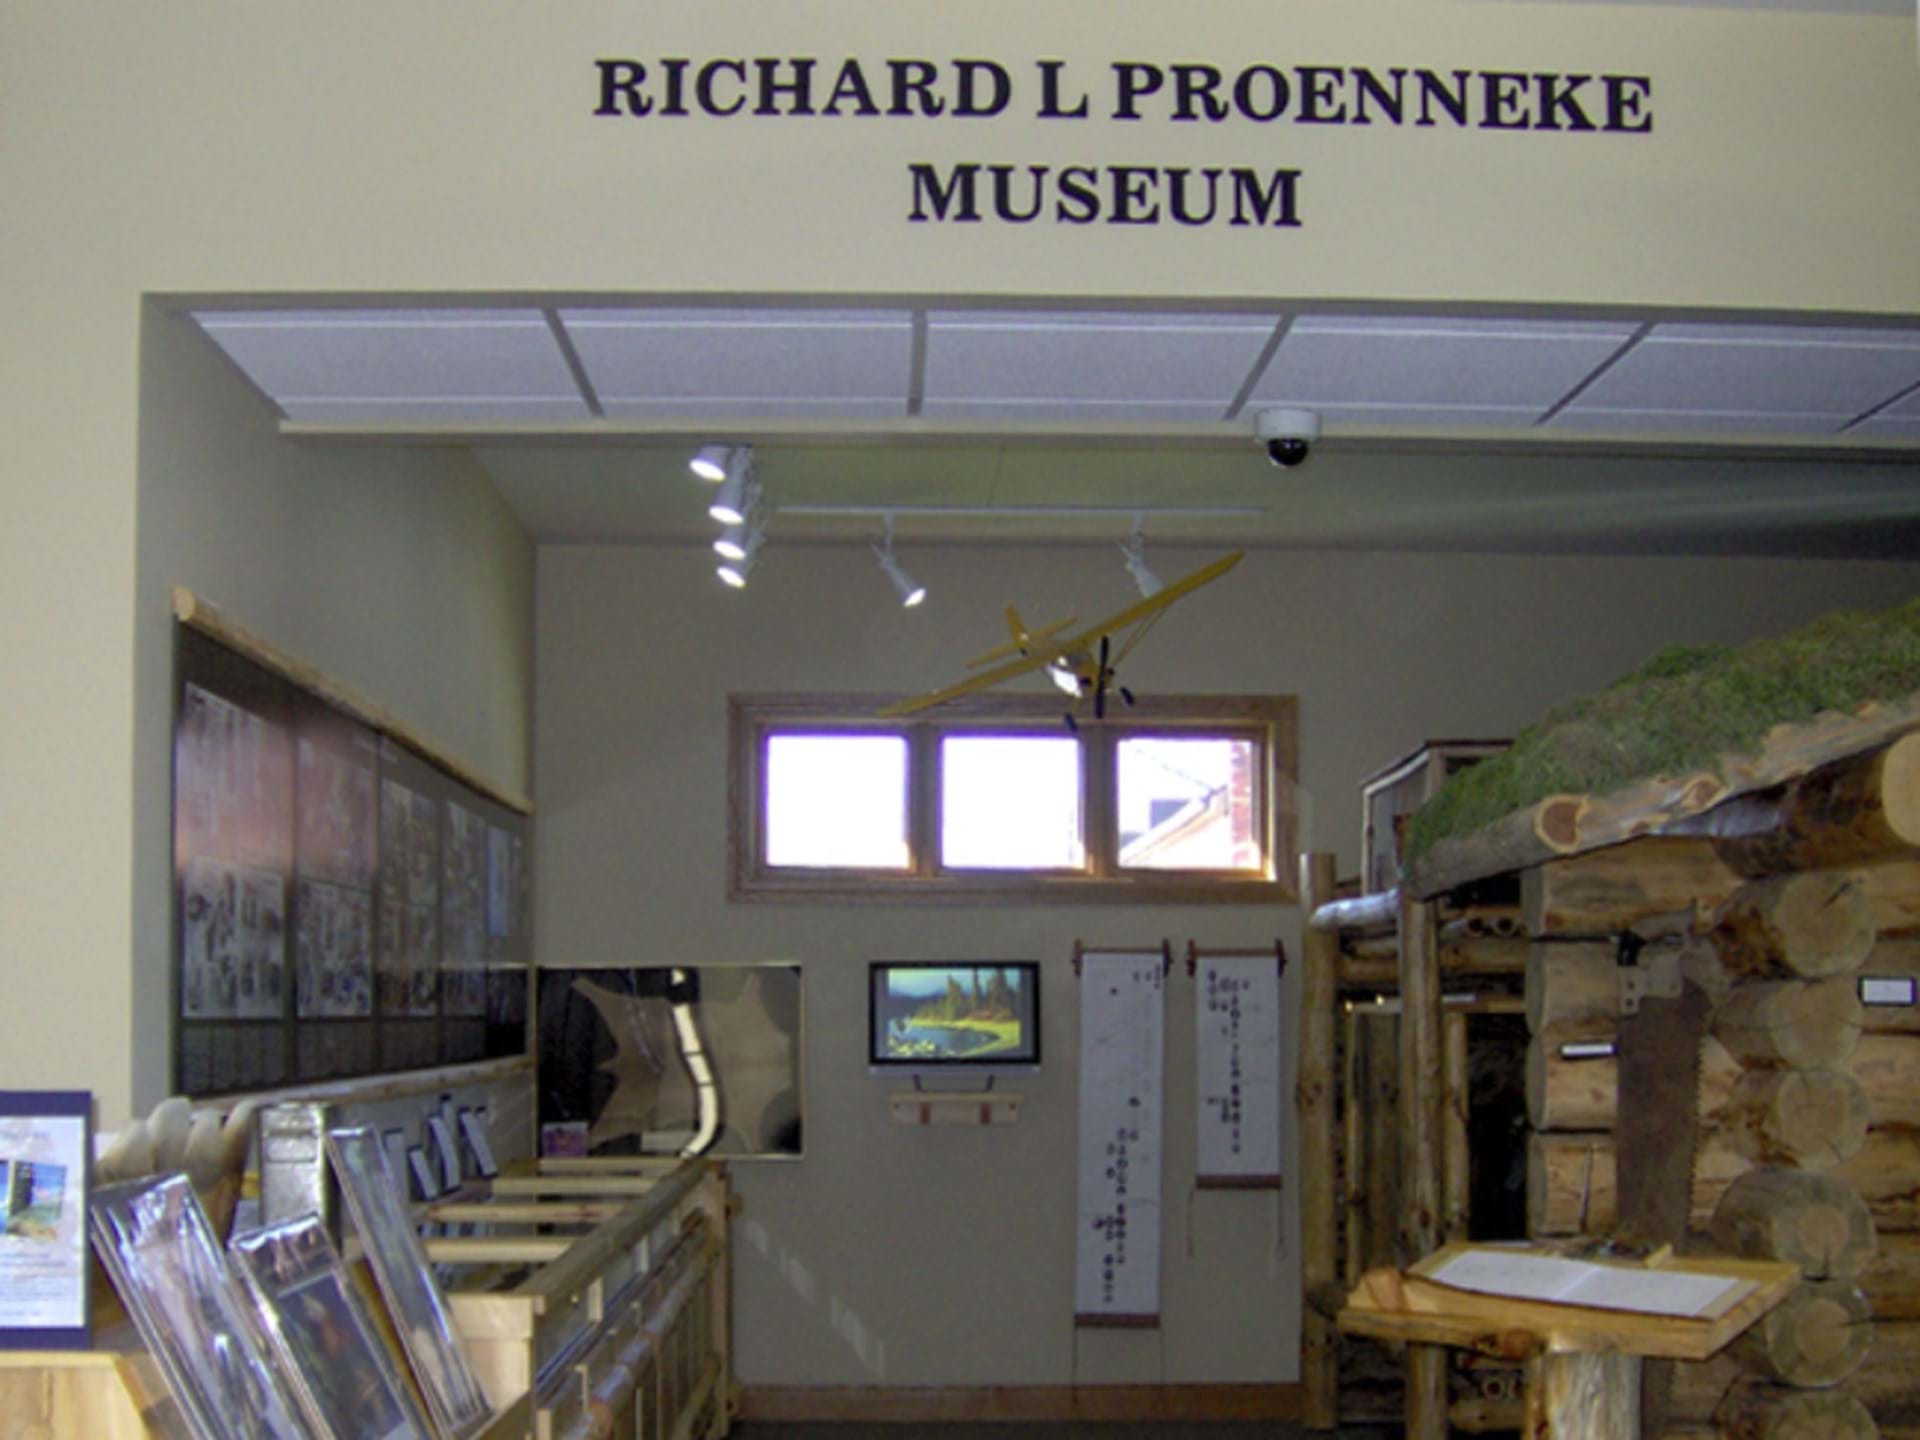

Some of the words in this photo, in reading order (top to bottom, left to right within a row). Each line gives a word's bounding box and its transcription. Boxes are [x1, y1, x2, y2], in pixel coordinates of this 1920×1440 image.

[593, 58, 1012, 118] RICHARD
[1036, 60, 1089, 119] L
[1111, 62, 1653, 134] PROENNEKE
[908, 163, 1303, 228] MUSEUM
